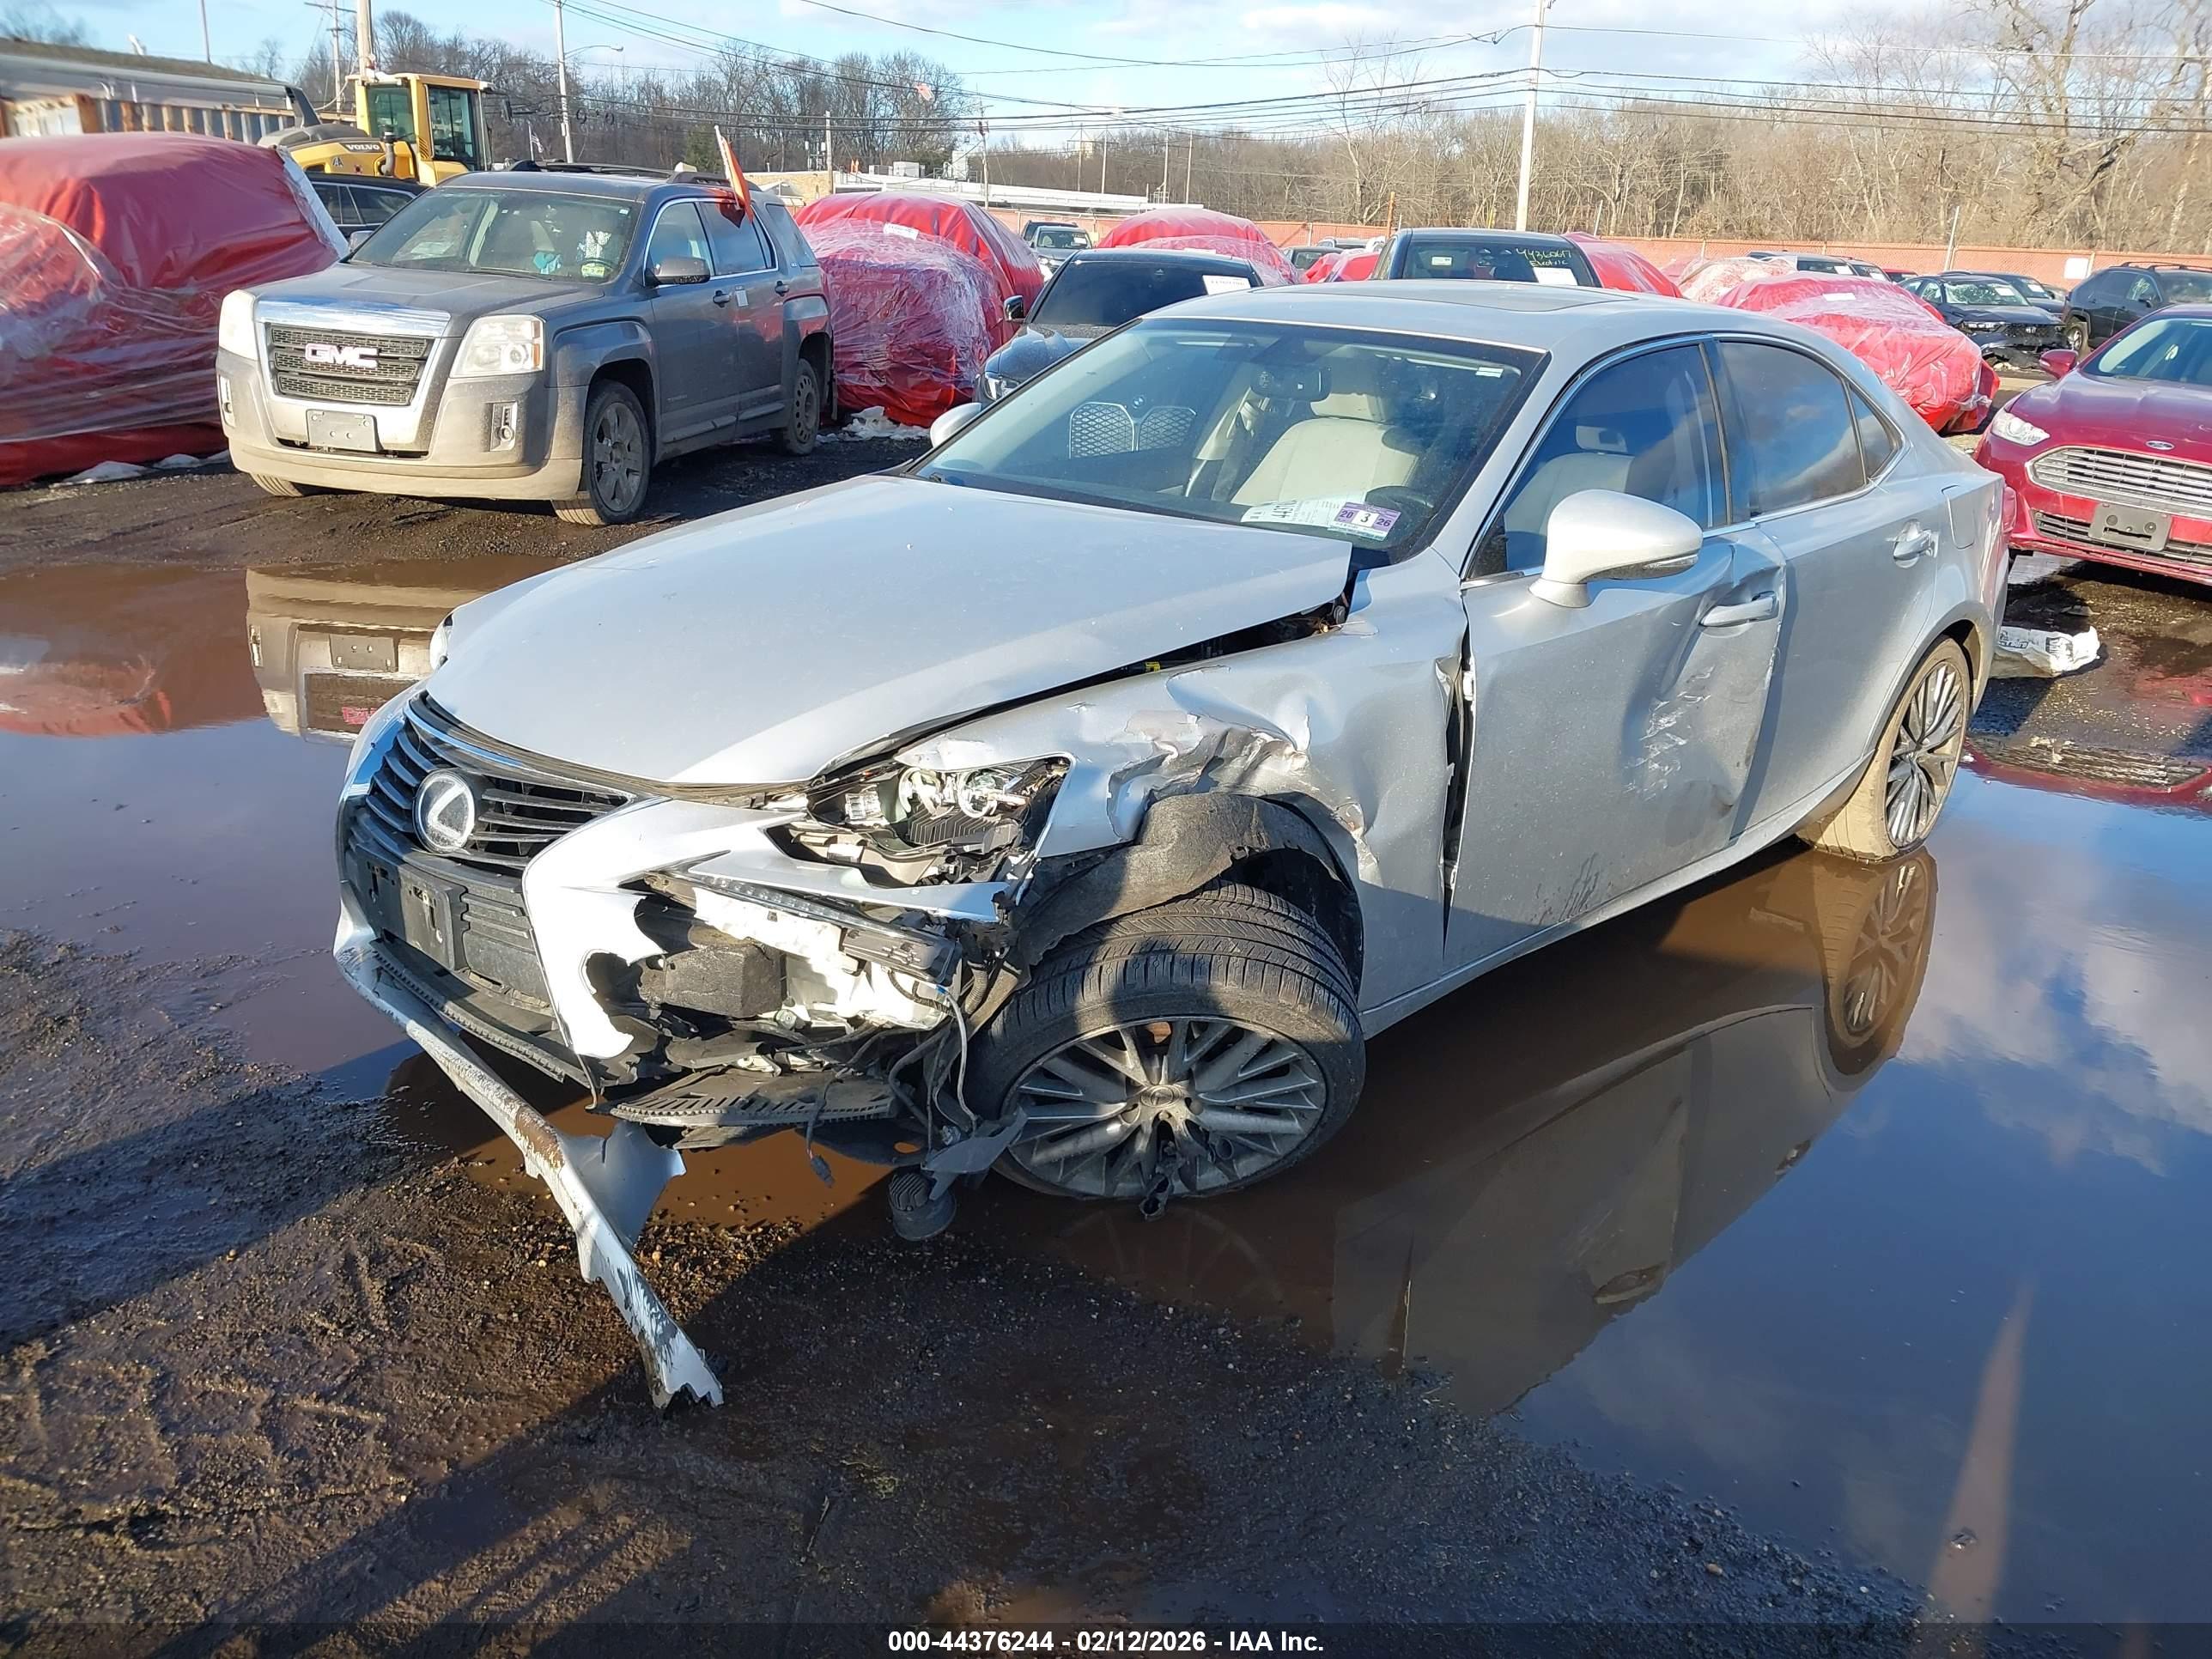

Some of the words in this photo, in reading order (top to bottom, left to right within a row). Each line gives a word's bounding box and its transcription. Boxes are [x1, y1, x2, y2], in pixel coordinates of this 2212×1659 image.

[305, 343, 378, 368] GMC
[1340, 510, 1354, 519] 20
[1360, 513, 1371, 523] 3
[1376, 518, 1392, 527] 26
